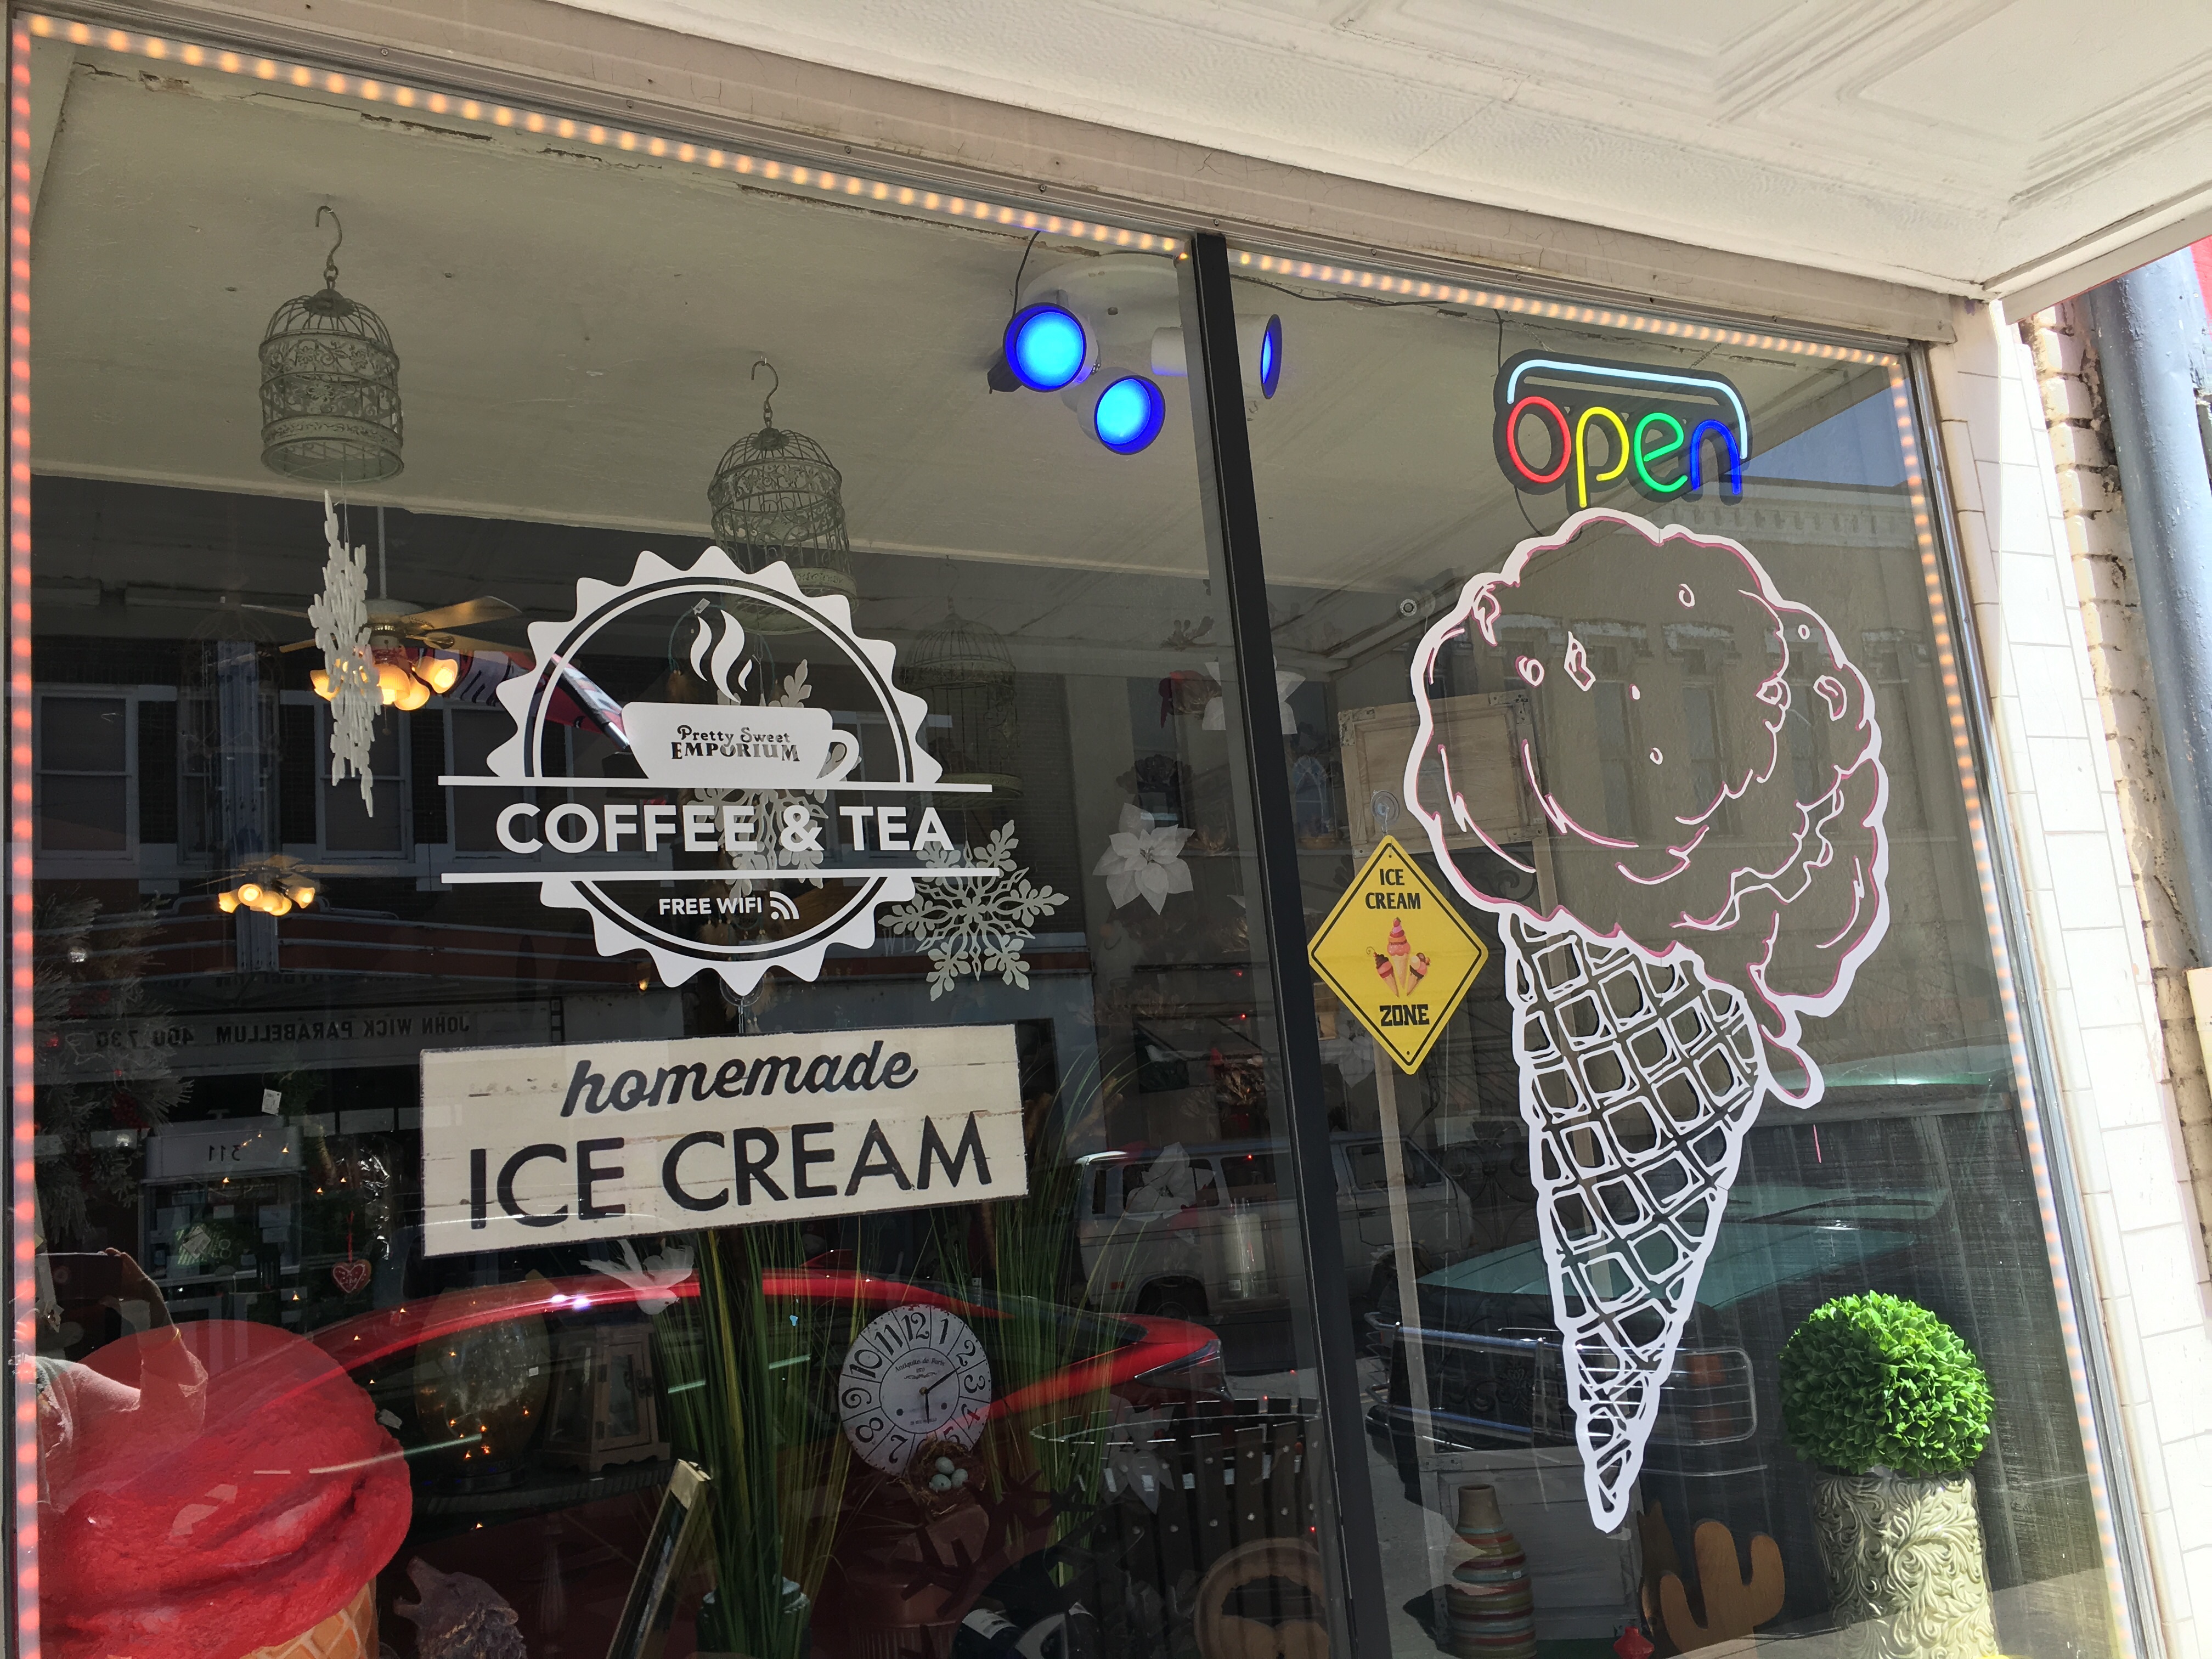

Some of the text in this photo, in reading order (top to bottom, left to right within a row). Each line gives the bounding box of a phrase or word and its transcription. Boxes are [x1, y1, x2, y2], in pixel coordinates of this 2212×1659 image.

[677, 724, 790, 747] Pretty Sweet
[671, 742, 800, 762] EMPORIUM
[496, 803, 954, 854] COFFEE & TEA
[1379, 868, 1405, 885] ICE
[659, 897, 762, 915] FREE WIFI
[1365, 892, 1421, 910] CREAM
[1379, 1004, 1430, 1026] ZONE
[560, 1040, 919, 1118] homemade
[470, 1111, 992, 1229] ICE CREAM
[874, 1324, 904, 1356] 11
[901, 1312, 930, 1342] 12
[940, 1318, 949, 1345] 1
[849, 1349, 883, 1379] 10
[956, 1339, 976, 1367] 2
[963, 1374, 986, 1394] 3
[841, 1387, 872, 1409] 9
[855, 1417, 884, 1443] 8
[961, 1403, 980, 1430] 4
[889, 1434, 908, 1463] 7
